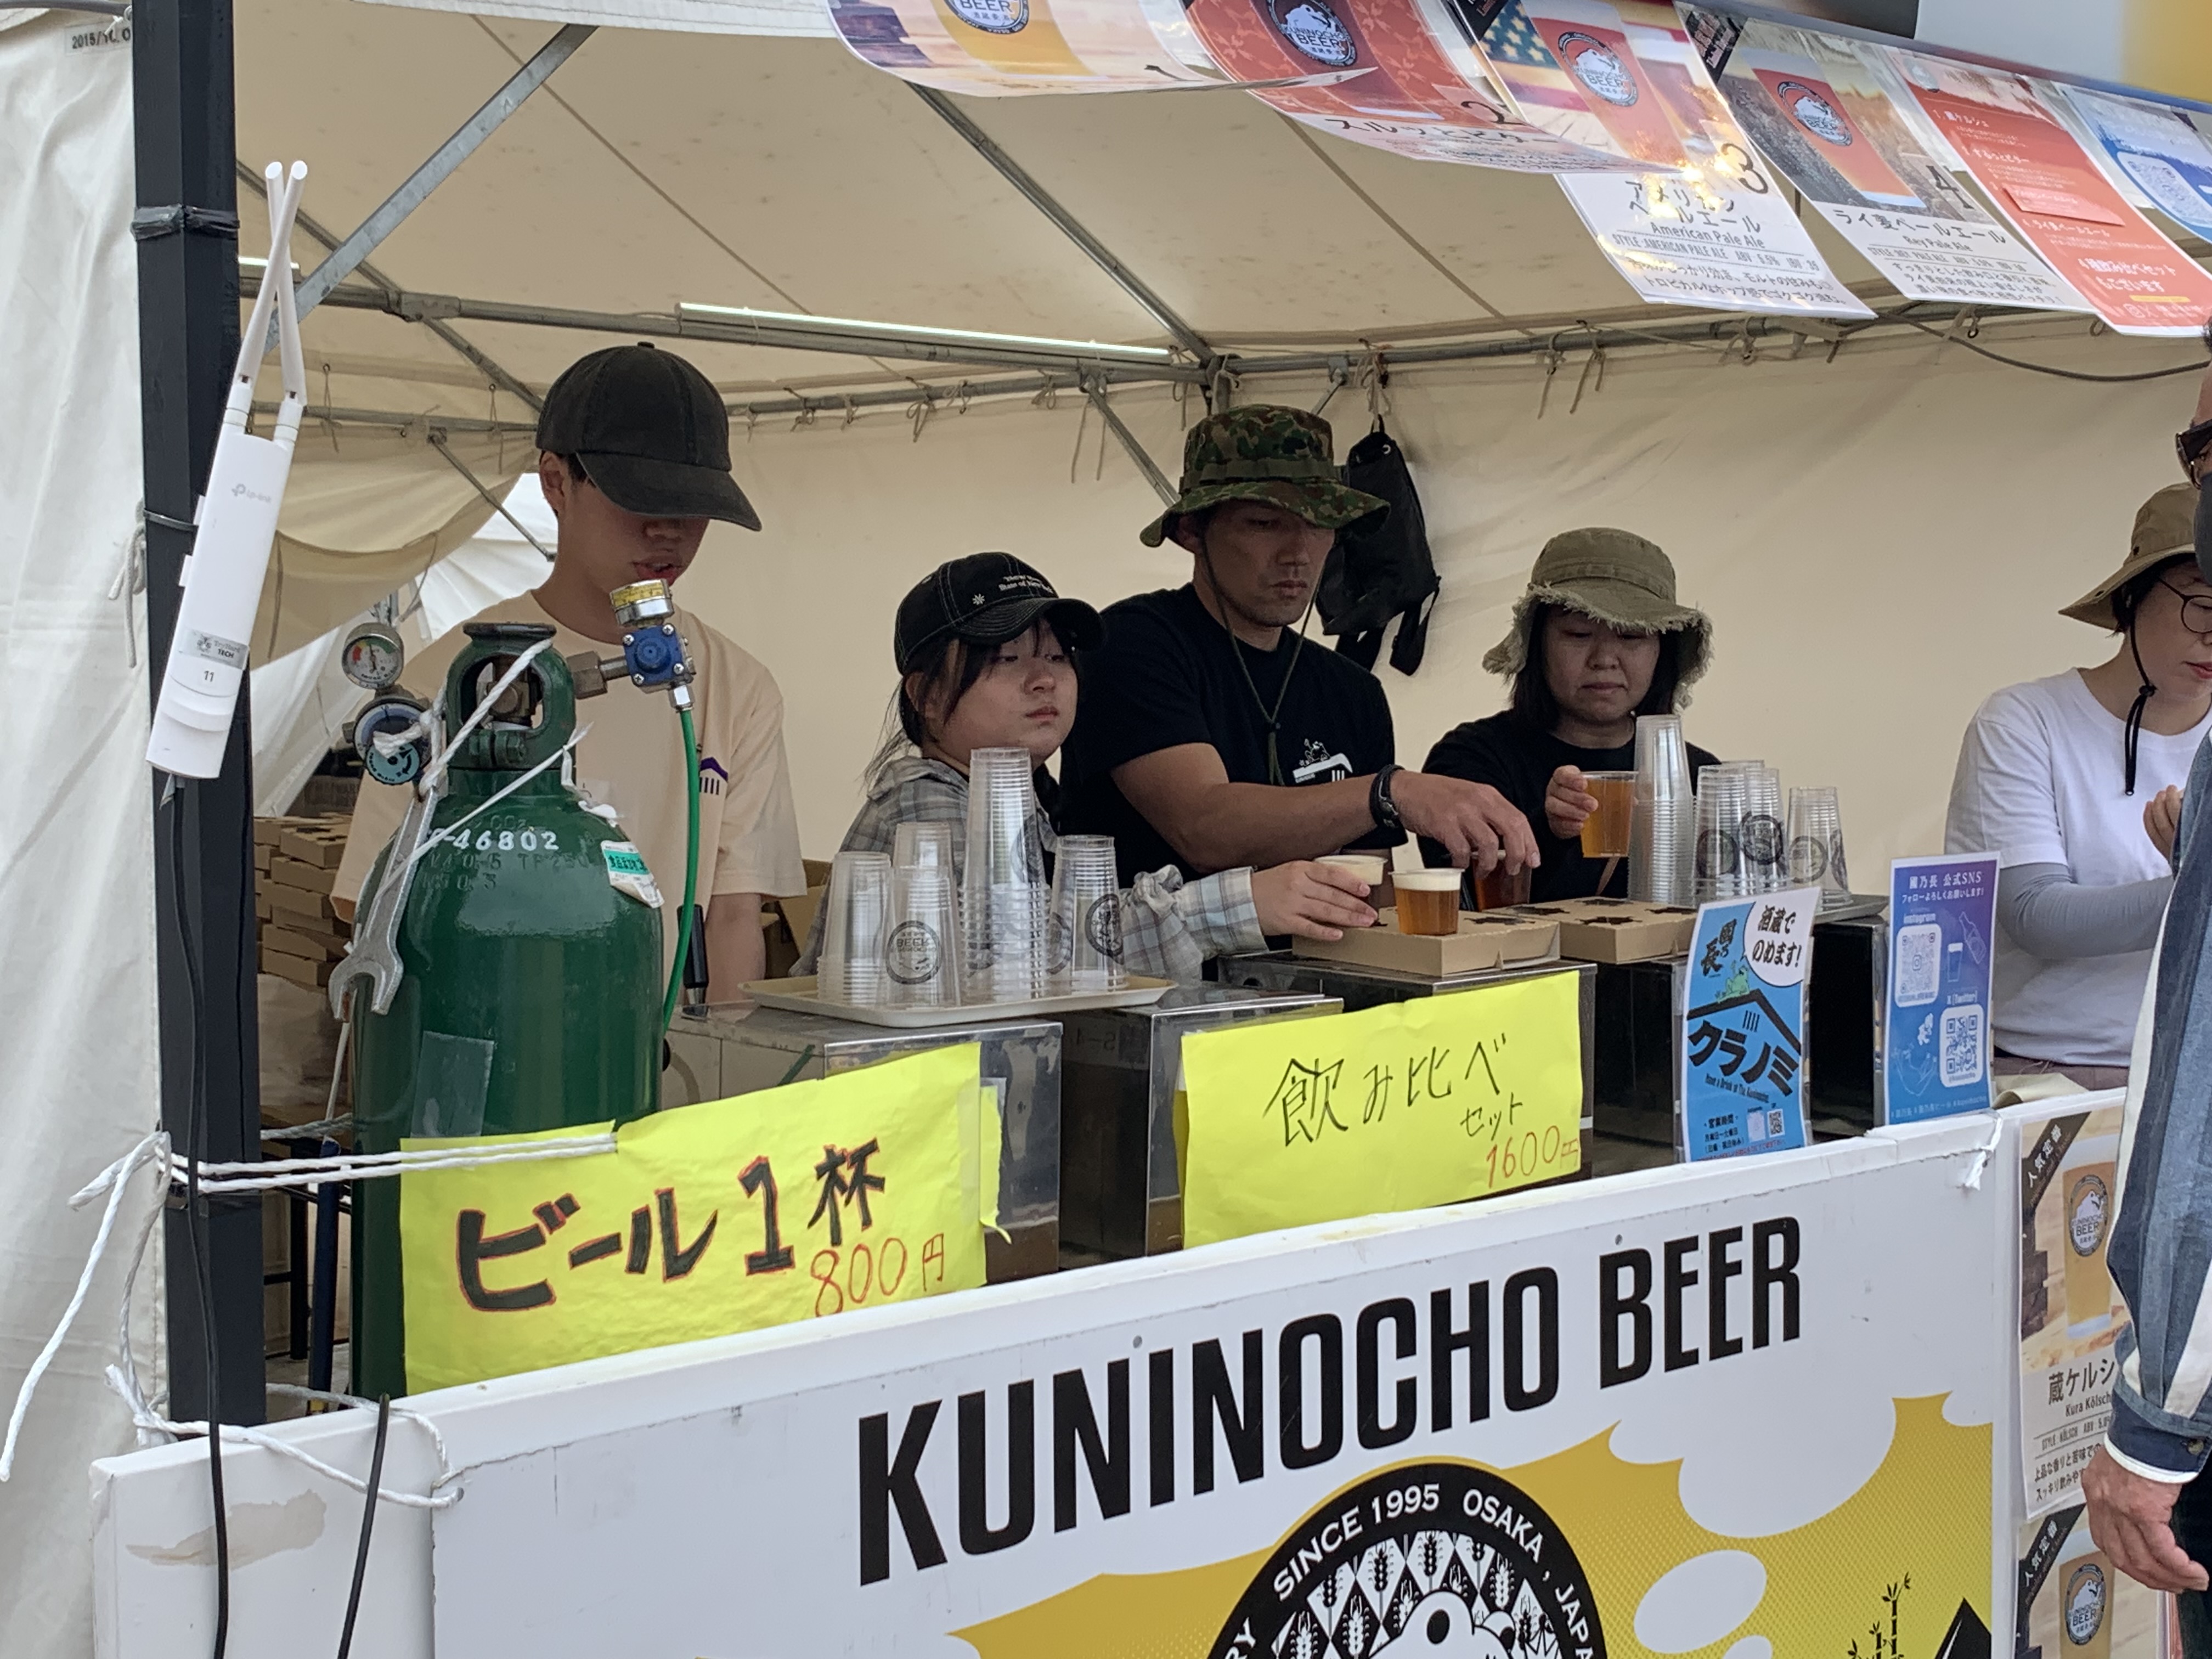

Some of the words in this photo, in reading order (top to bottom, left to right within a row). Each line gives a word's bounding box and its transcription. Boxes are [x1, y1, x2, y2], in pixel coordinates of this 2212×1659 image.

[1296, 33, 1341, 48] BEER
[1721, 143, 1768, 193] 3
[1926, 165, 1975, 209] 4
[1651, 221, 1713, 241] American
[1714, 230, 1741, 245] Pale
[1743, 234, 1764, 249] Ale
[1833, 209, 2007, 244] ライ麦ペールエール
[202, 669, 216, 683] 11
[1943, 871, 1983, 887] 公式SNS
[1757, 905, 1797, 934] 酒蔵で
[1752, 939, 1802, 968] のめます!
[1687, 1019, 1799, 1097] クラノミ
[1262, 1032, 1507, 1147] 飲み比べ
[1459, 1092, 1523, 1141] セット
[1486, 1125, 1579, 1189] 1600円
[456, 1137, 886, 1312] ビール1杯
[2075, 1221, 2100, 1237] BEER
[810, 1233, 945, 1317] 800円
[859, 1266, 1559, 1587] KUNINOCHO
[1599, 1215, 1802, 1390] BEER
[2065, 1402, 2084, 1418] Kura
[2036, 1468, 2086, 1503] スッキリ飲みや
[1273, 1505, 1364, 1600] SINCE
[1372, 1483, 1441, 1525] 1995
[2072, 1608, 2096, 1627] BEER
